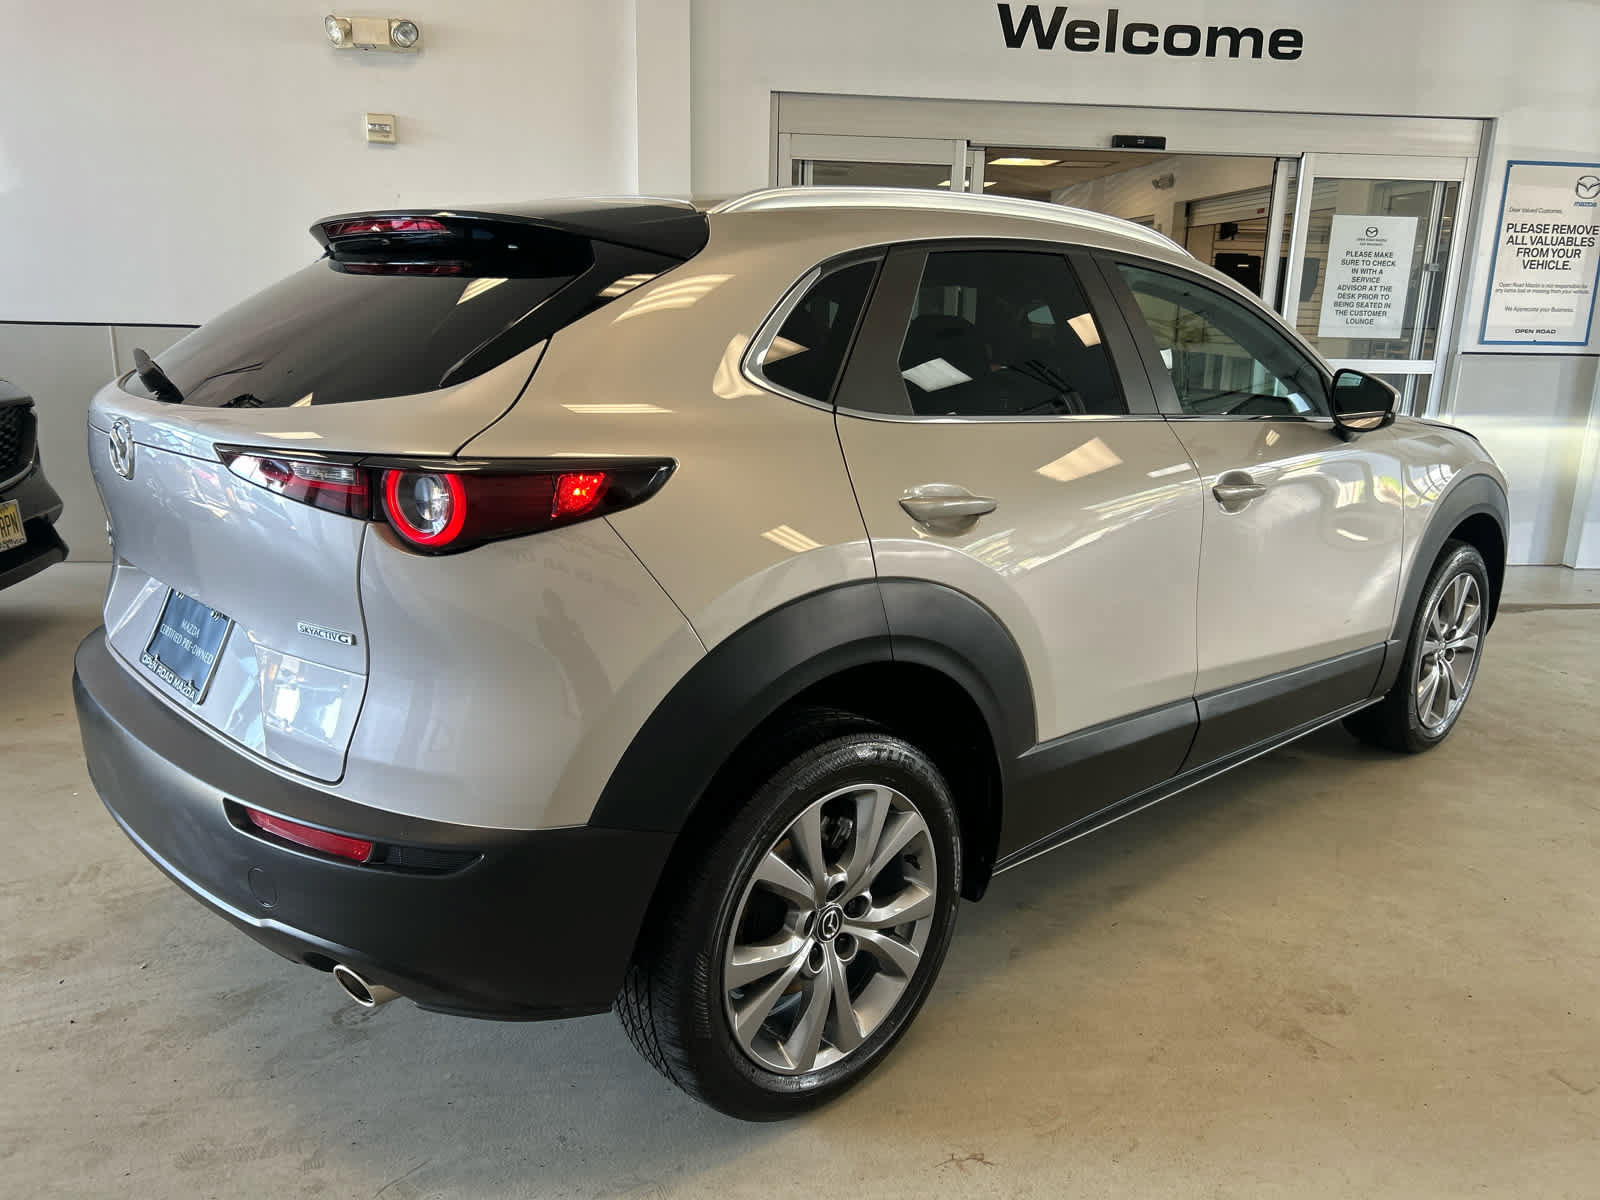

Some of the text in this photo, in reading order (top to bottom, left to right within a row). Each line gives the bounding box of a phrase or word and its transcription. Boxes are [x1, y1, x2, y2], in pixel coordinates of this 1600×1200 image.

[997, 3, 1304, 60] Welcome
[1506, 223, 1600, 236] PLEASE REMOVE
[1506, 235, 1596, 247] ALL VALUABLES
[1345, 250, 1394, 259] PLEASE MAKE
[1516, 247, 1582, 259] FROM YOUR
[1522, 259, 1572, 271] VEHICLE.
[1351, 276, 1381, 284] SERVICE
[1356, 301, 1383, 309] SEATED
[182, 619, 201, 638] MAZDA
[142, 654, 196, 700] OPEN ROAD MAZDA
